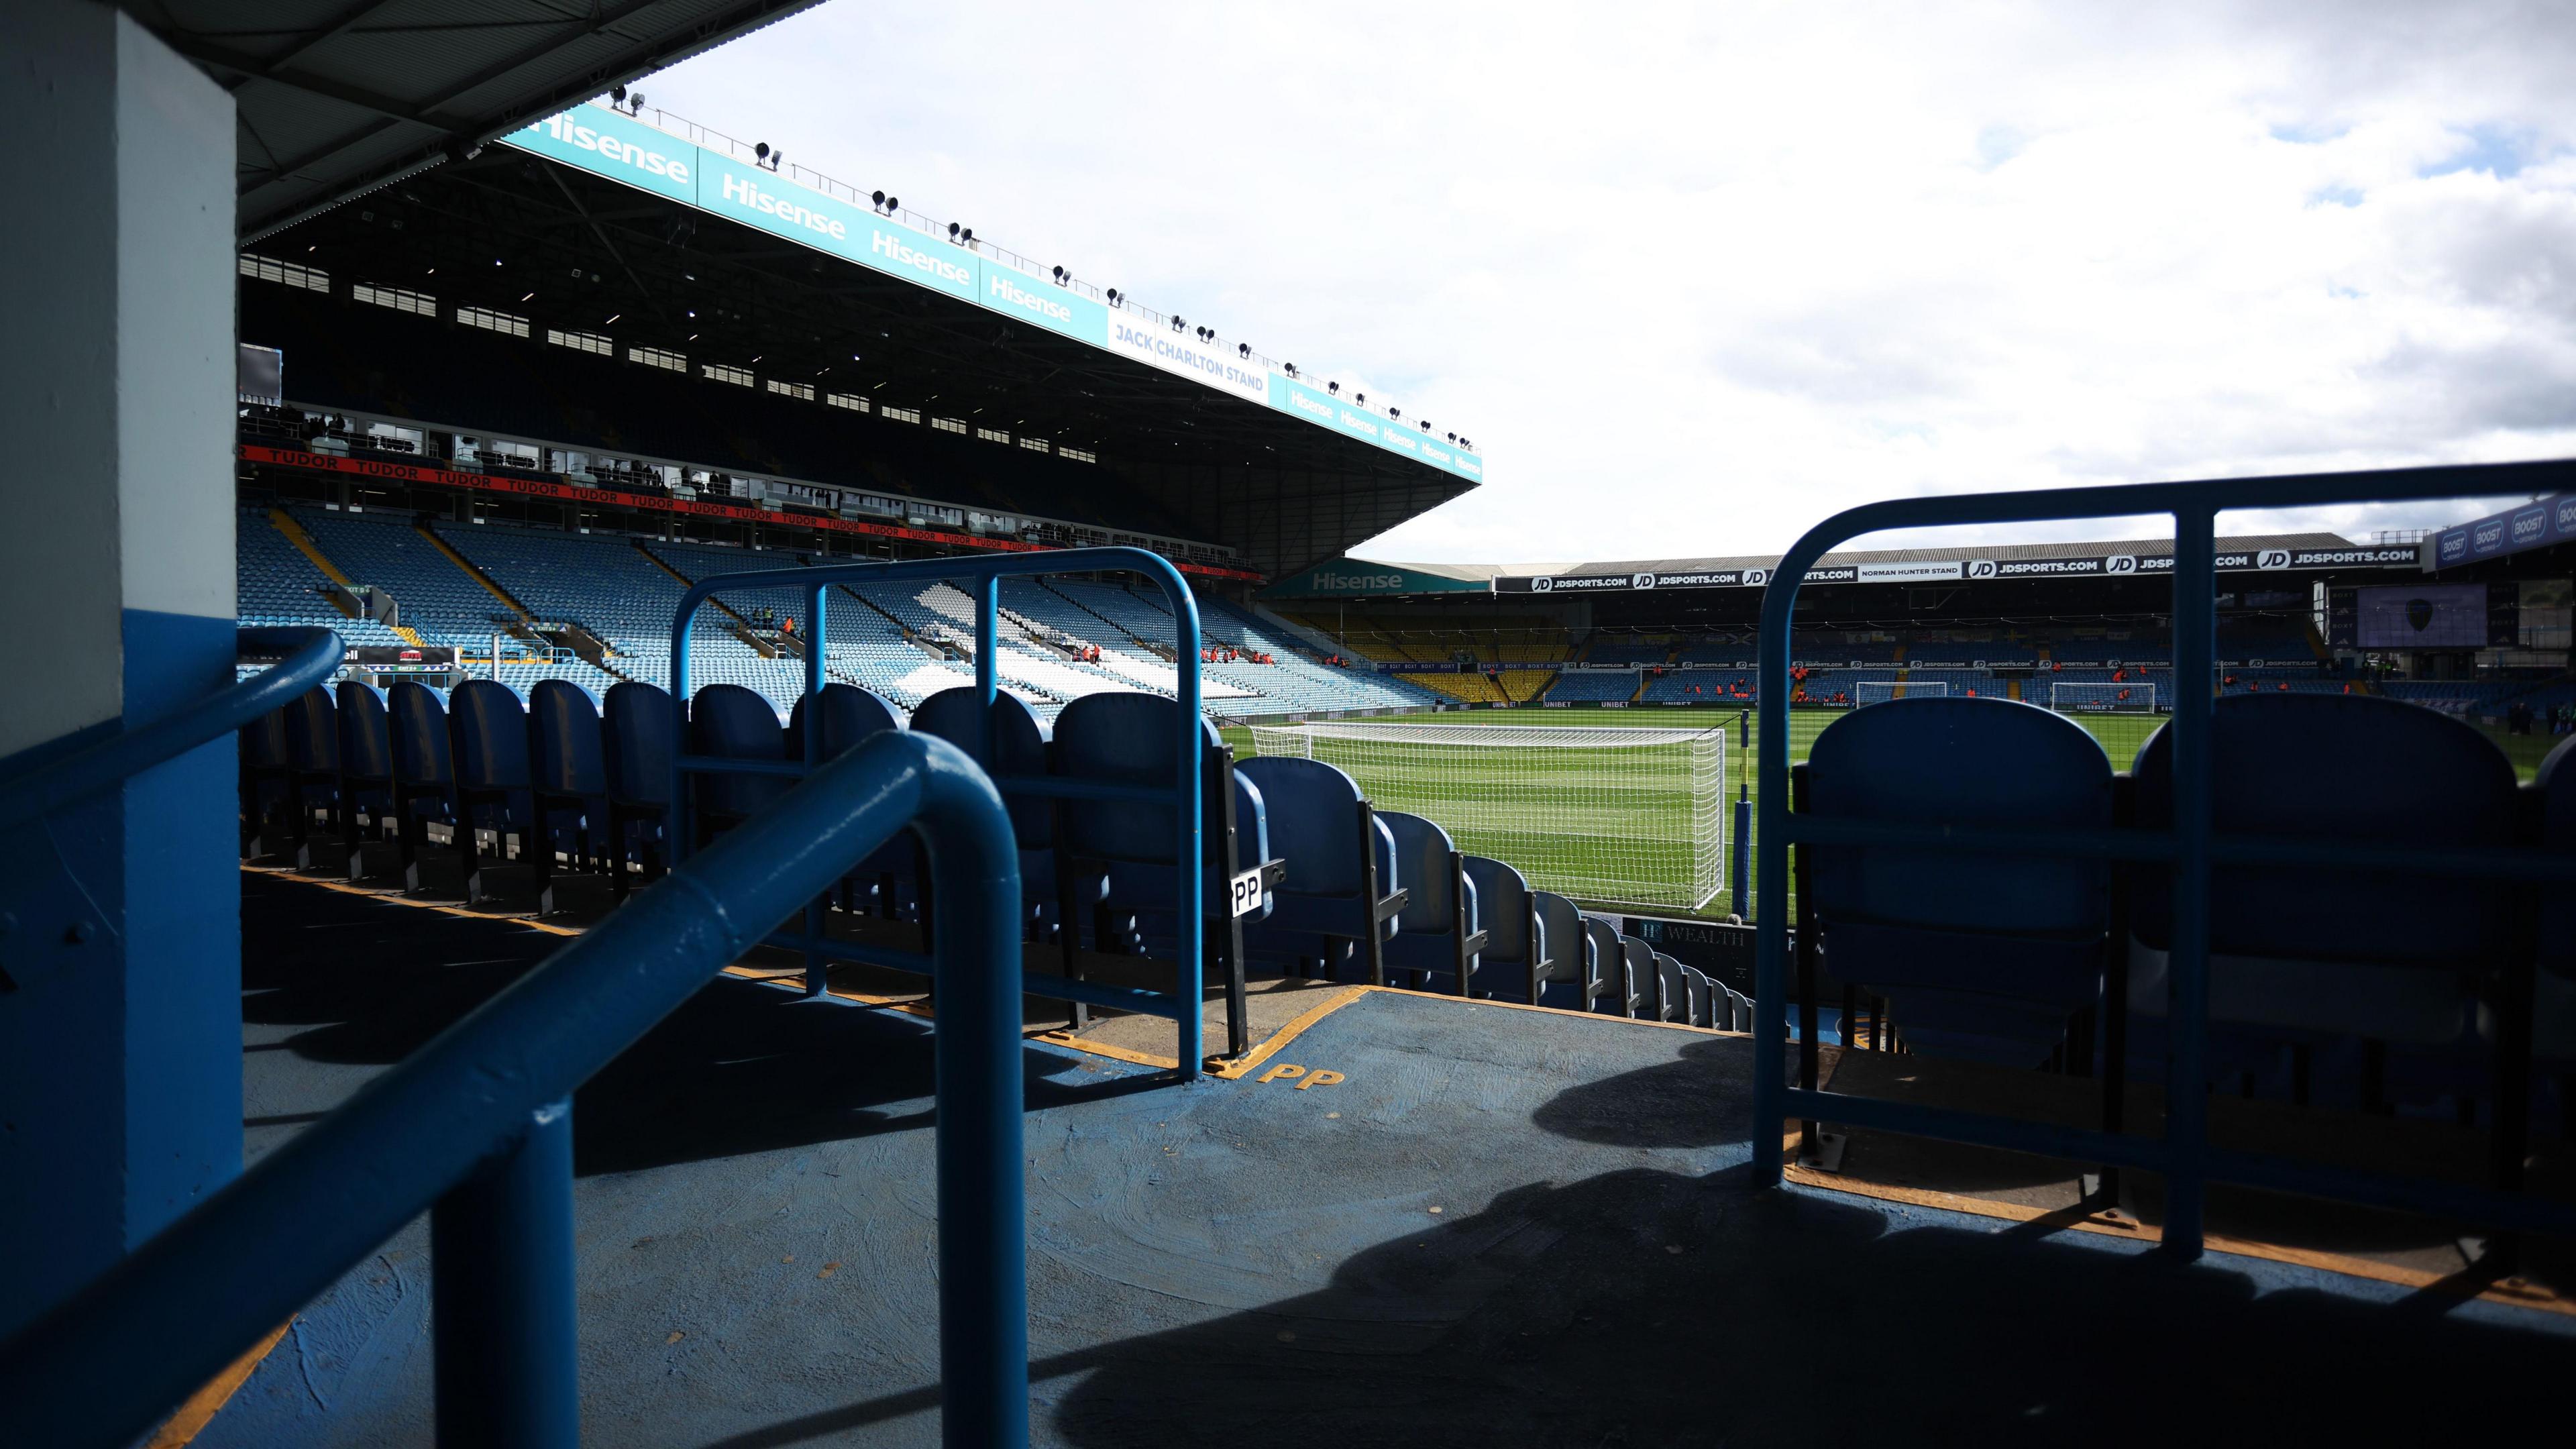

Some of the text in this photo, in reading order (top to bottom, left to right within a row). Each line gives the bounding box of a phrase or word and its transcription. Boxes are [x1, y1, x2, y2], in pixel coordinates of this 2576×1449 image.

[531, 111, 688, 185] Hisense
[722, 172, 846, 241] Hisense
[872, 229, 971, 286] Hisense
[991, 275, 1071, 323] Hisense
[1116, 324, 1263, 392] JACK CHARLTON STAND
[1291, 390, 1333, 419] Hisense
[1341, 409, 1378, 436] Hisense
[1383, 426, 1416, 451] Hisense
[269, 449, 338, 469] TUDOR
[1421, 441, 1450, 464] Hisense
[356, 461, 418, 479] TUDOR
[1455, 453, 1481, 476] Hisense
[435, 471, 491, 488] TUDOR
[507, 480, 559, 495] TUDOR
[570, 488, 618, 502] TUDOR
[631, 496, 674, 509] TUDOR
[687, 503, 727, 516] TUDOR
[735, 508, 771, 521] TUDOR
[782, 514, 817, 525] TUDOR
[826, 519, 859, 531] TUDOR
[2514, 516, 2543, 535] BOOST
[868, 525, 899, 536] TUDOR
[907, 530, 936, 541] TUDOR
[2476, 528, 2502, 545] BOOST
[944, 534, 971, 545] TUDOR
[976, 538, 1002, 548] TUDOR
[1008, 542, 1032, 551] TUDOR
[2443, 538, 2465, 553] BOOST
[2110, 557, 2133, 573] JD
[2261, 551, 2414, 567] JD JDSPORTS.COM
[1746, 570, 1854, 584] JD RTS.COM
[1972, 561, 2098, 577] JD JDSPORTS.COM
[1313, 573, 1403, 590] Hisense
[1534, 578, 1627, 590] JD JDSPORTS.COM
[1635, 575, 1735, 587] JD JDSPORTS.COM
[1289, 714, 1308, 722] UNIBET
[1328, 711, 1345, 720] UNIBET
[1361, 709, 1377, 717] UNIBET
[1393, 707, 1407, 715] UNIBET
[1225, 717, 1247, 727] UNIBET
[1234, 876, 1258, 912] PP
[1667, 926, 1744, 947] WEALTH
[1255, 1063, 1345, 1090] PP
